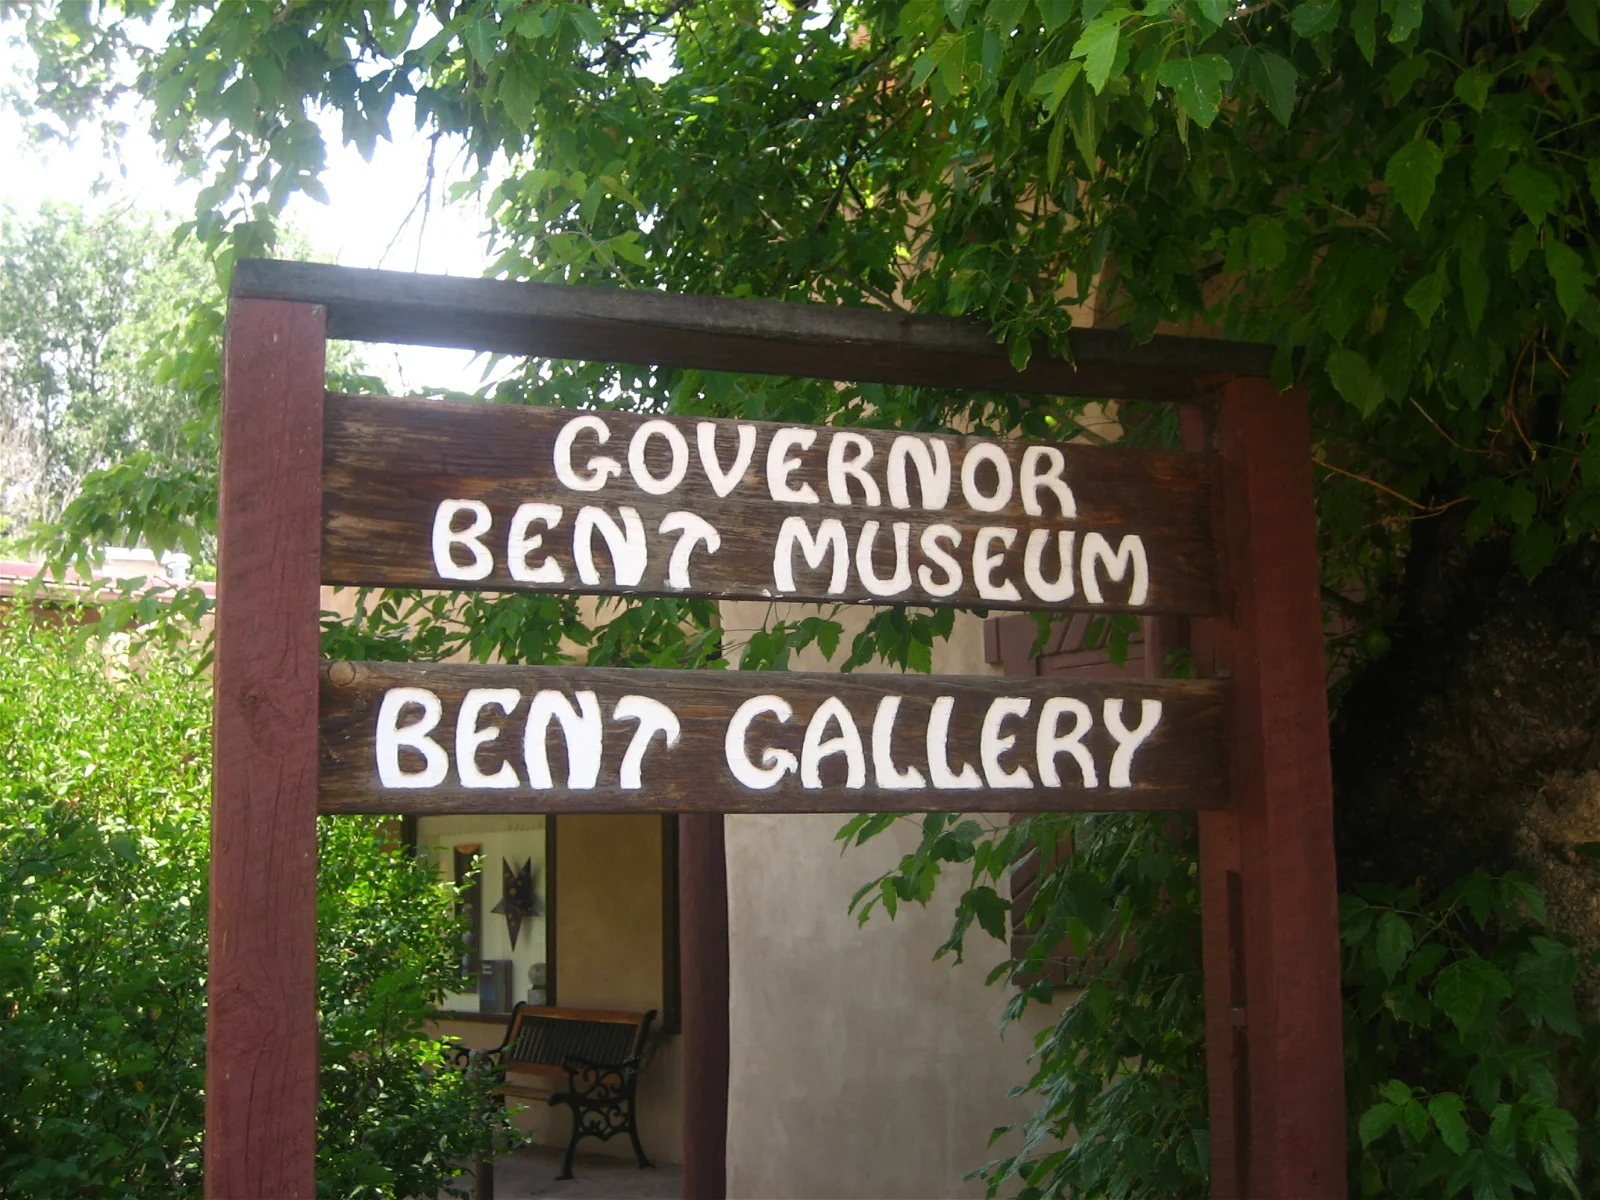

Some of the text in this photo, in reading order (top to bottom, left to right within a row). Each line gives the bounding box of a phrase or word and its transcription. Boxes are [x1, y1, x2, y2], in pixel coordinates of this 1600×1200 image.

[553, 414, 1077, 519] GOVERNOR
[432, 498, 1150, 607] BENT MUSEUM
[375, 687, 1163, 791] BENT GALLERY
